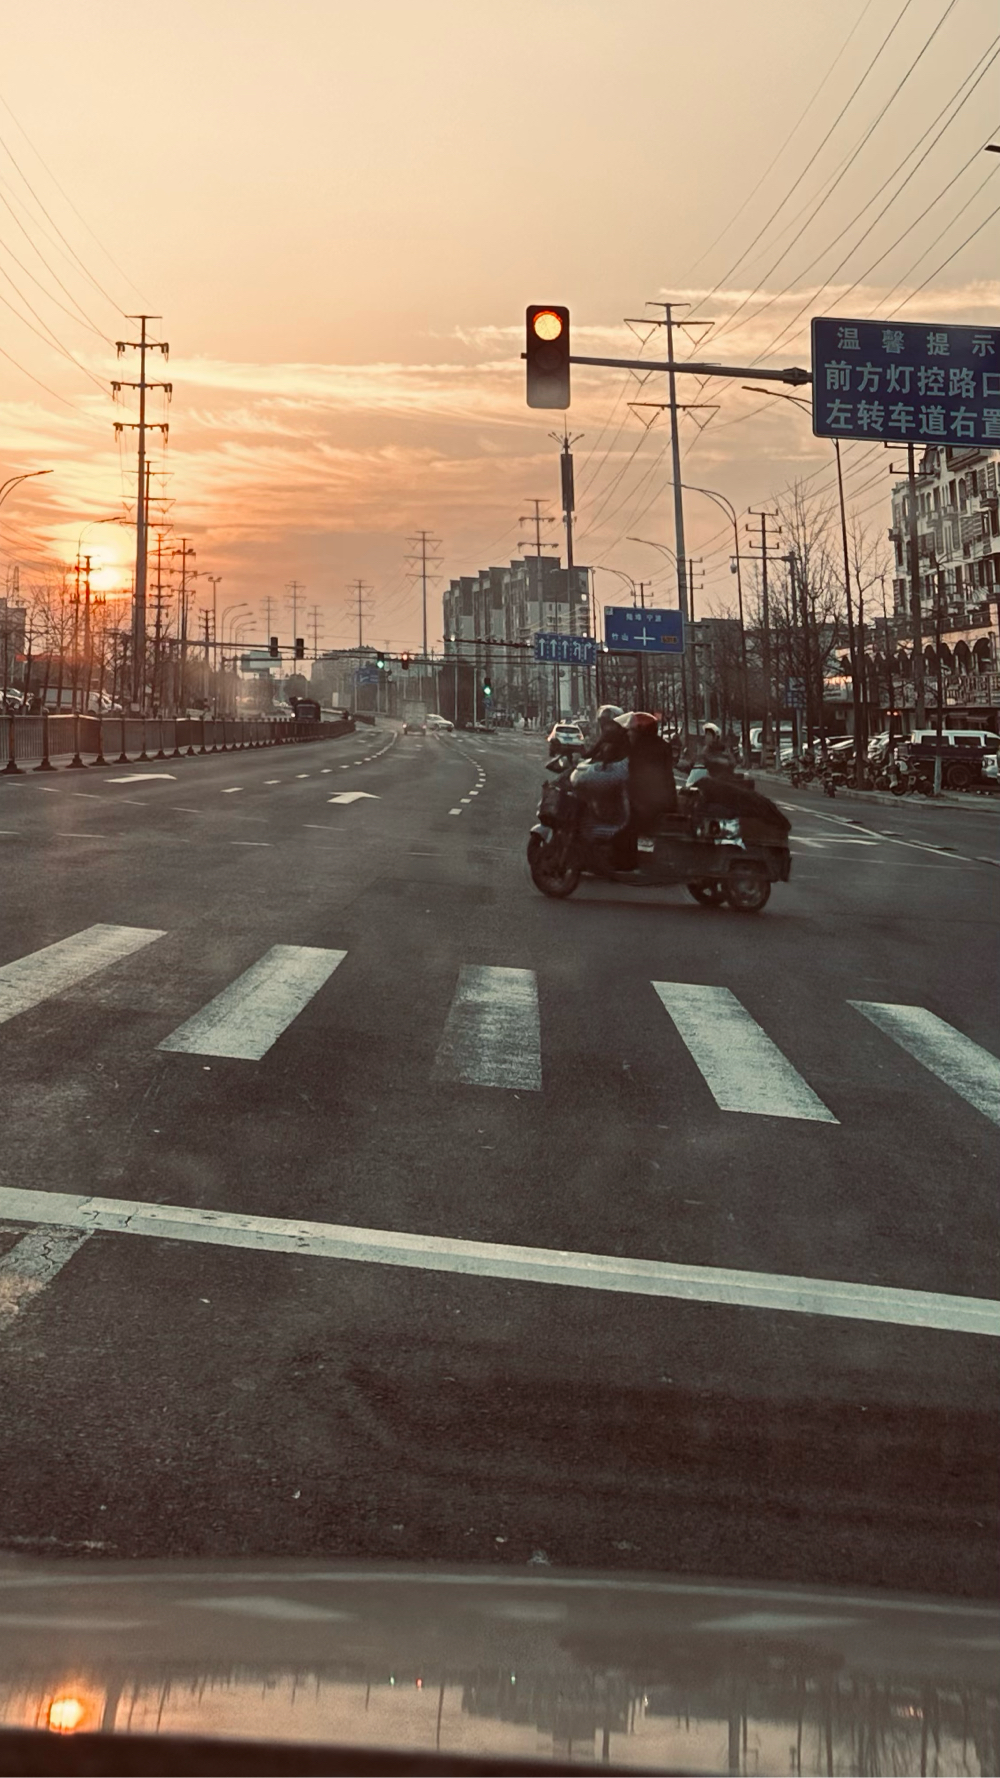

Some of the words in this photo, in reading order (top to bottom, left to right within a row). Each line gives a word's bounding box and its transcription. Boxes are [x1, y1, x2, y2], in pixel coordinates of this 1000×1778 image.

[837, 326, 996, 358] 温馨提示
[824, 360, 1000, 399] 前方灯控路口
[825, 399, 1000, 439] 左转车道右置
